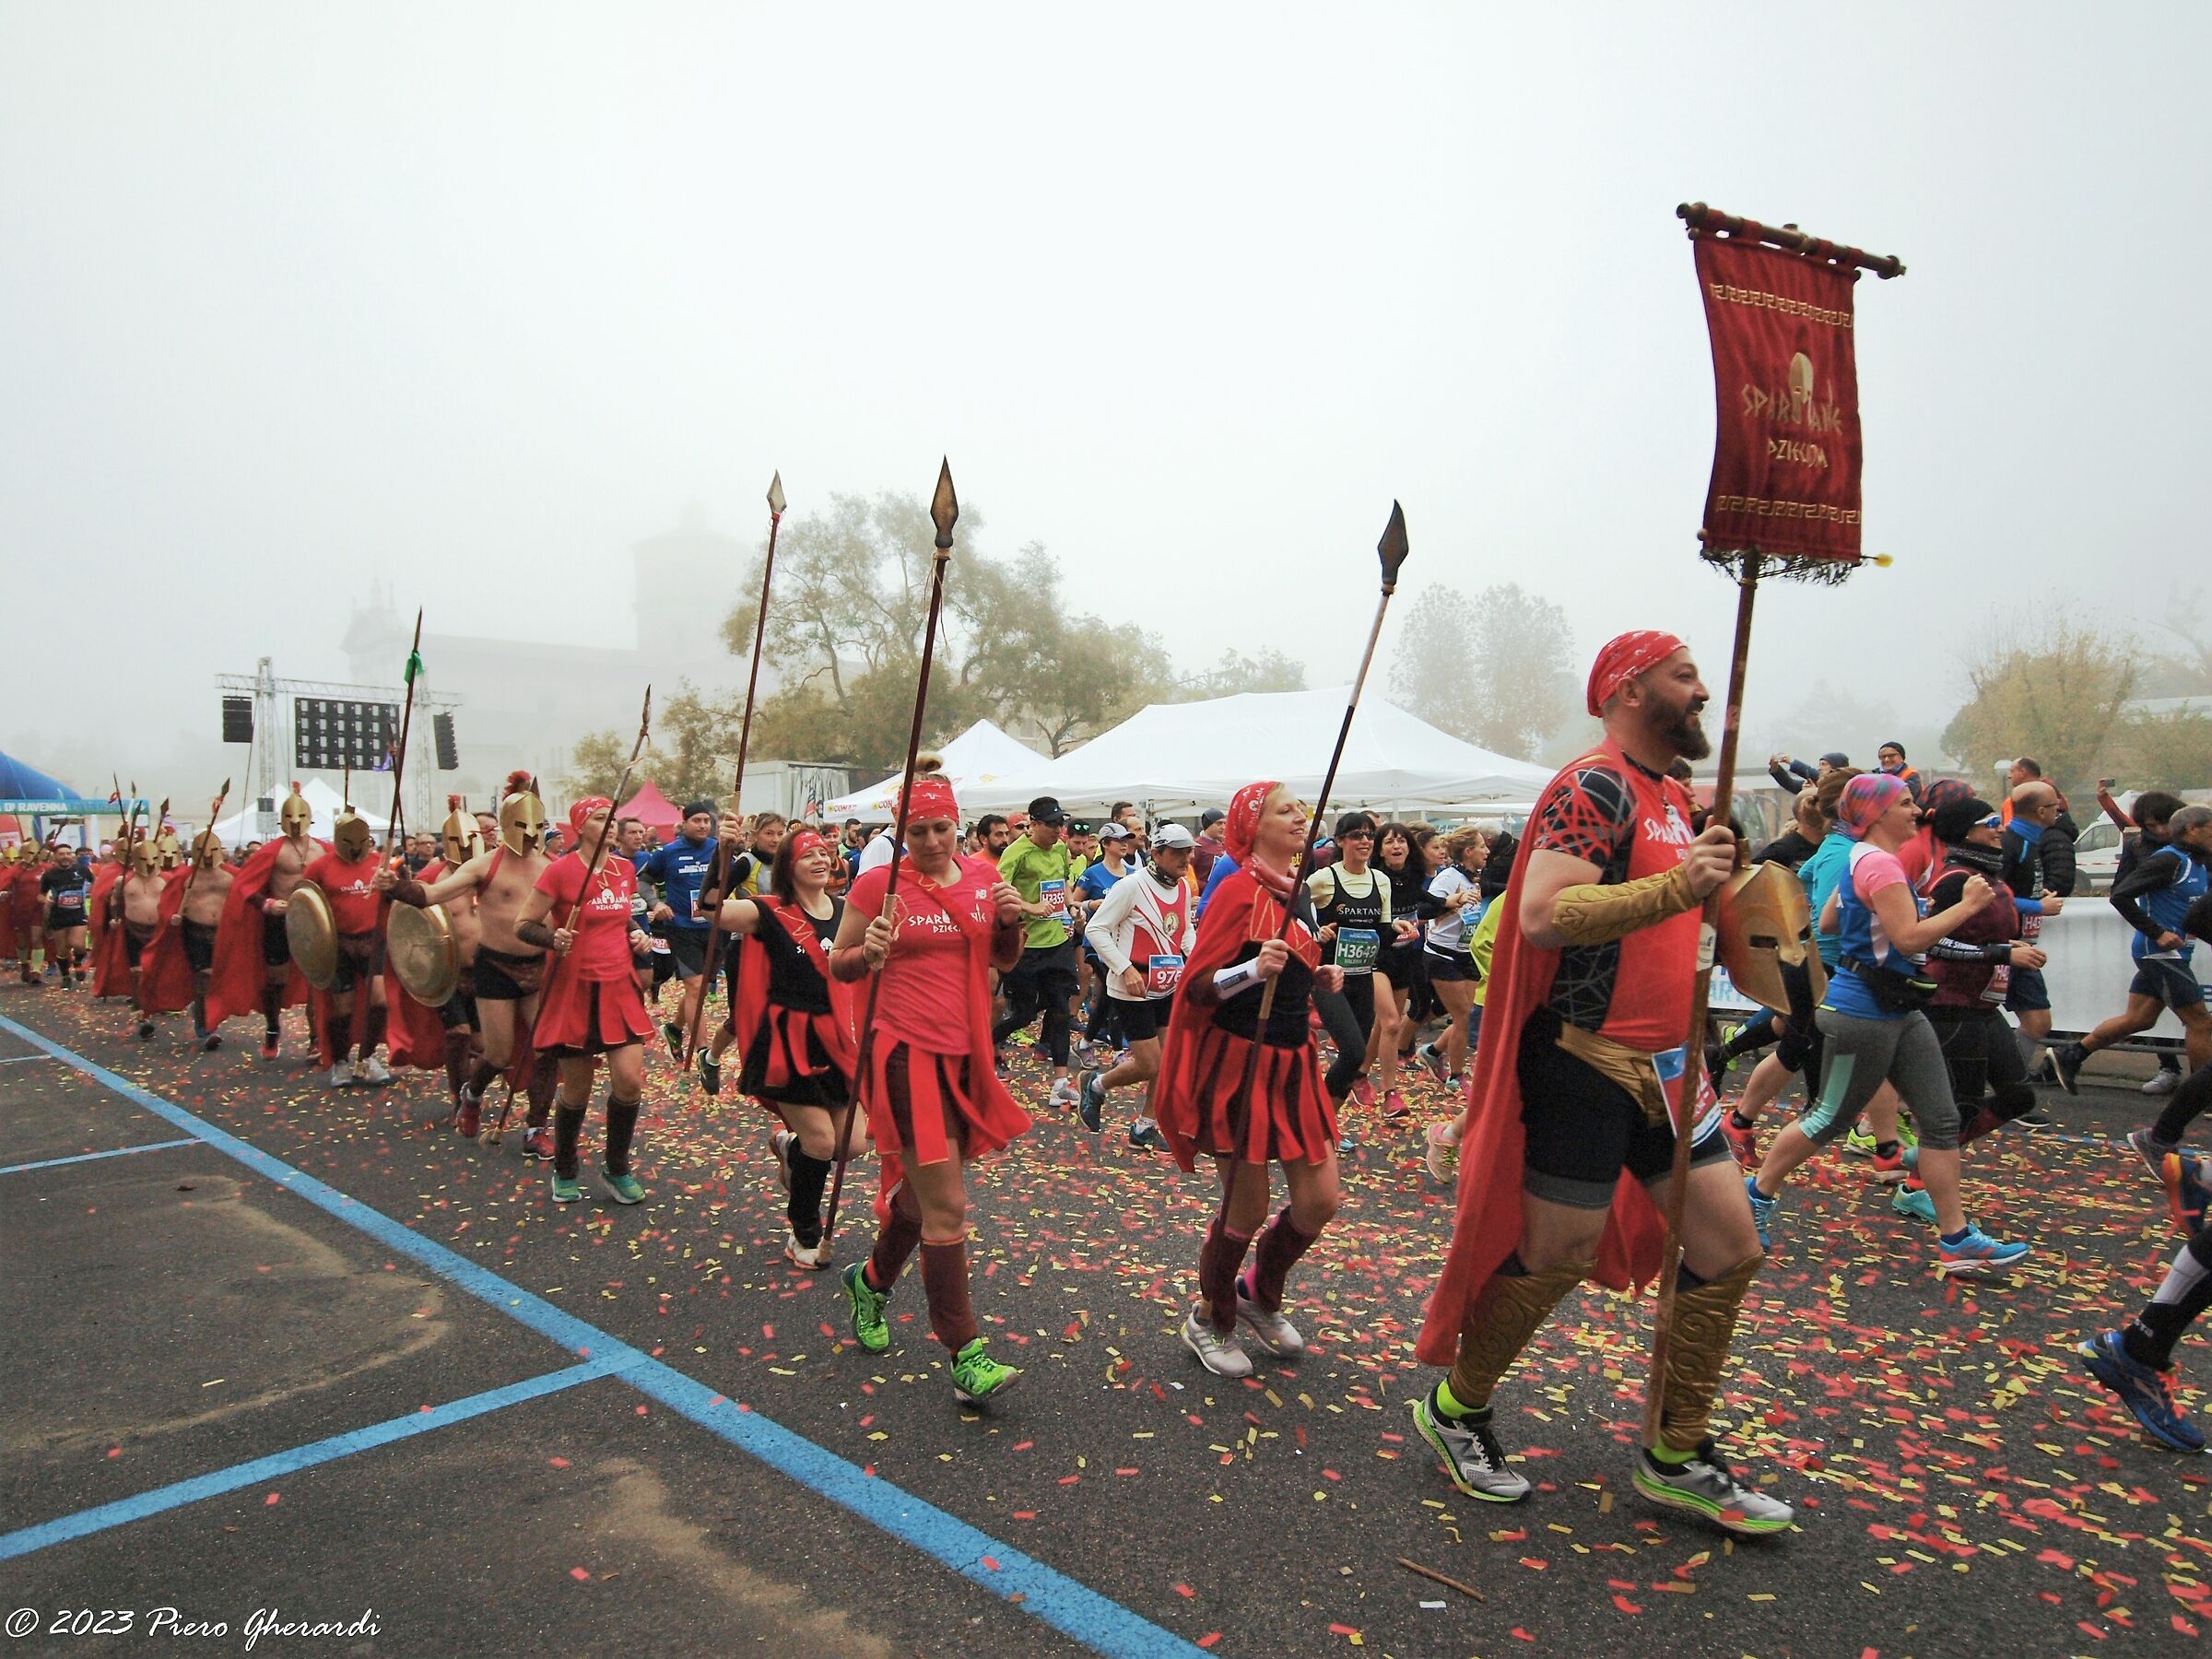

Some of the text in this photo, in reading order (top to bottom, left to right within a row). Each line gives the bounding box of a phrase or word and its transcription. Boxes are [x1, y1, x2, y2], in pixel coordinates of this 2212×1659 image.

[18, 802, 68, 812] RAVENNA
[1338, 907, 1381, 915] SPARTAN
[1338, 943, 1377, 959] H3649
